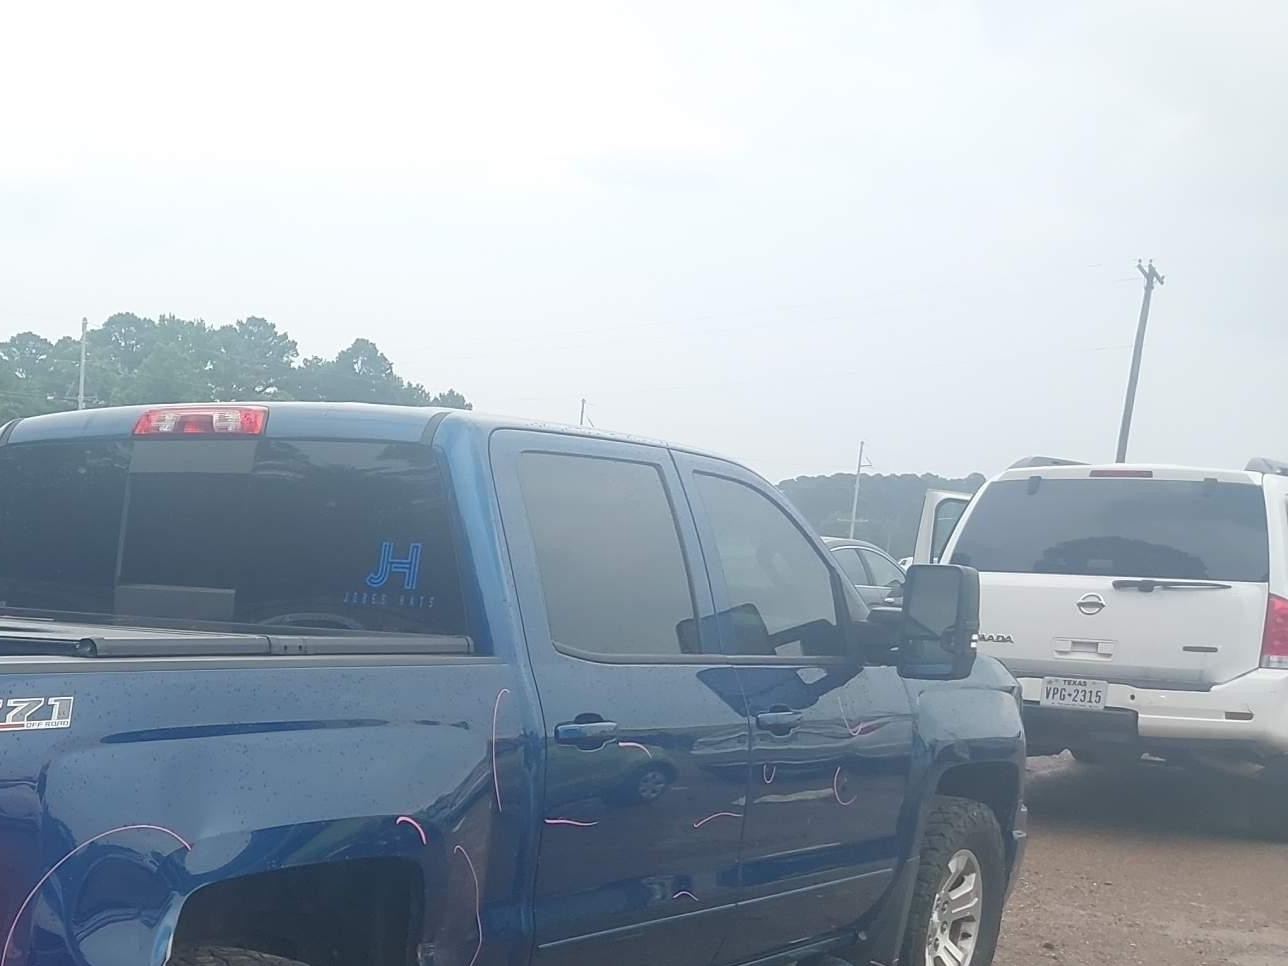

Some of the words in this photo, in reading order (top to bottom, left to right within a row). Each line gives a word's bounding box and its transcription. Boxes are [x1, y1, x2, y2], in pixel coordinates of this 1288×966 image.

[366, 541, 423, 590] JH
[979, 633, 1014, 643] MADA
[1063, 679, 1088, 687] TEXAS
[25, 720, 43, 729] OFF
[44, 719, 69, 728] ROAD
